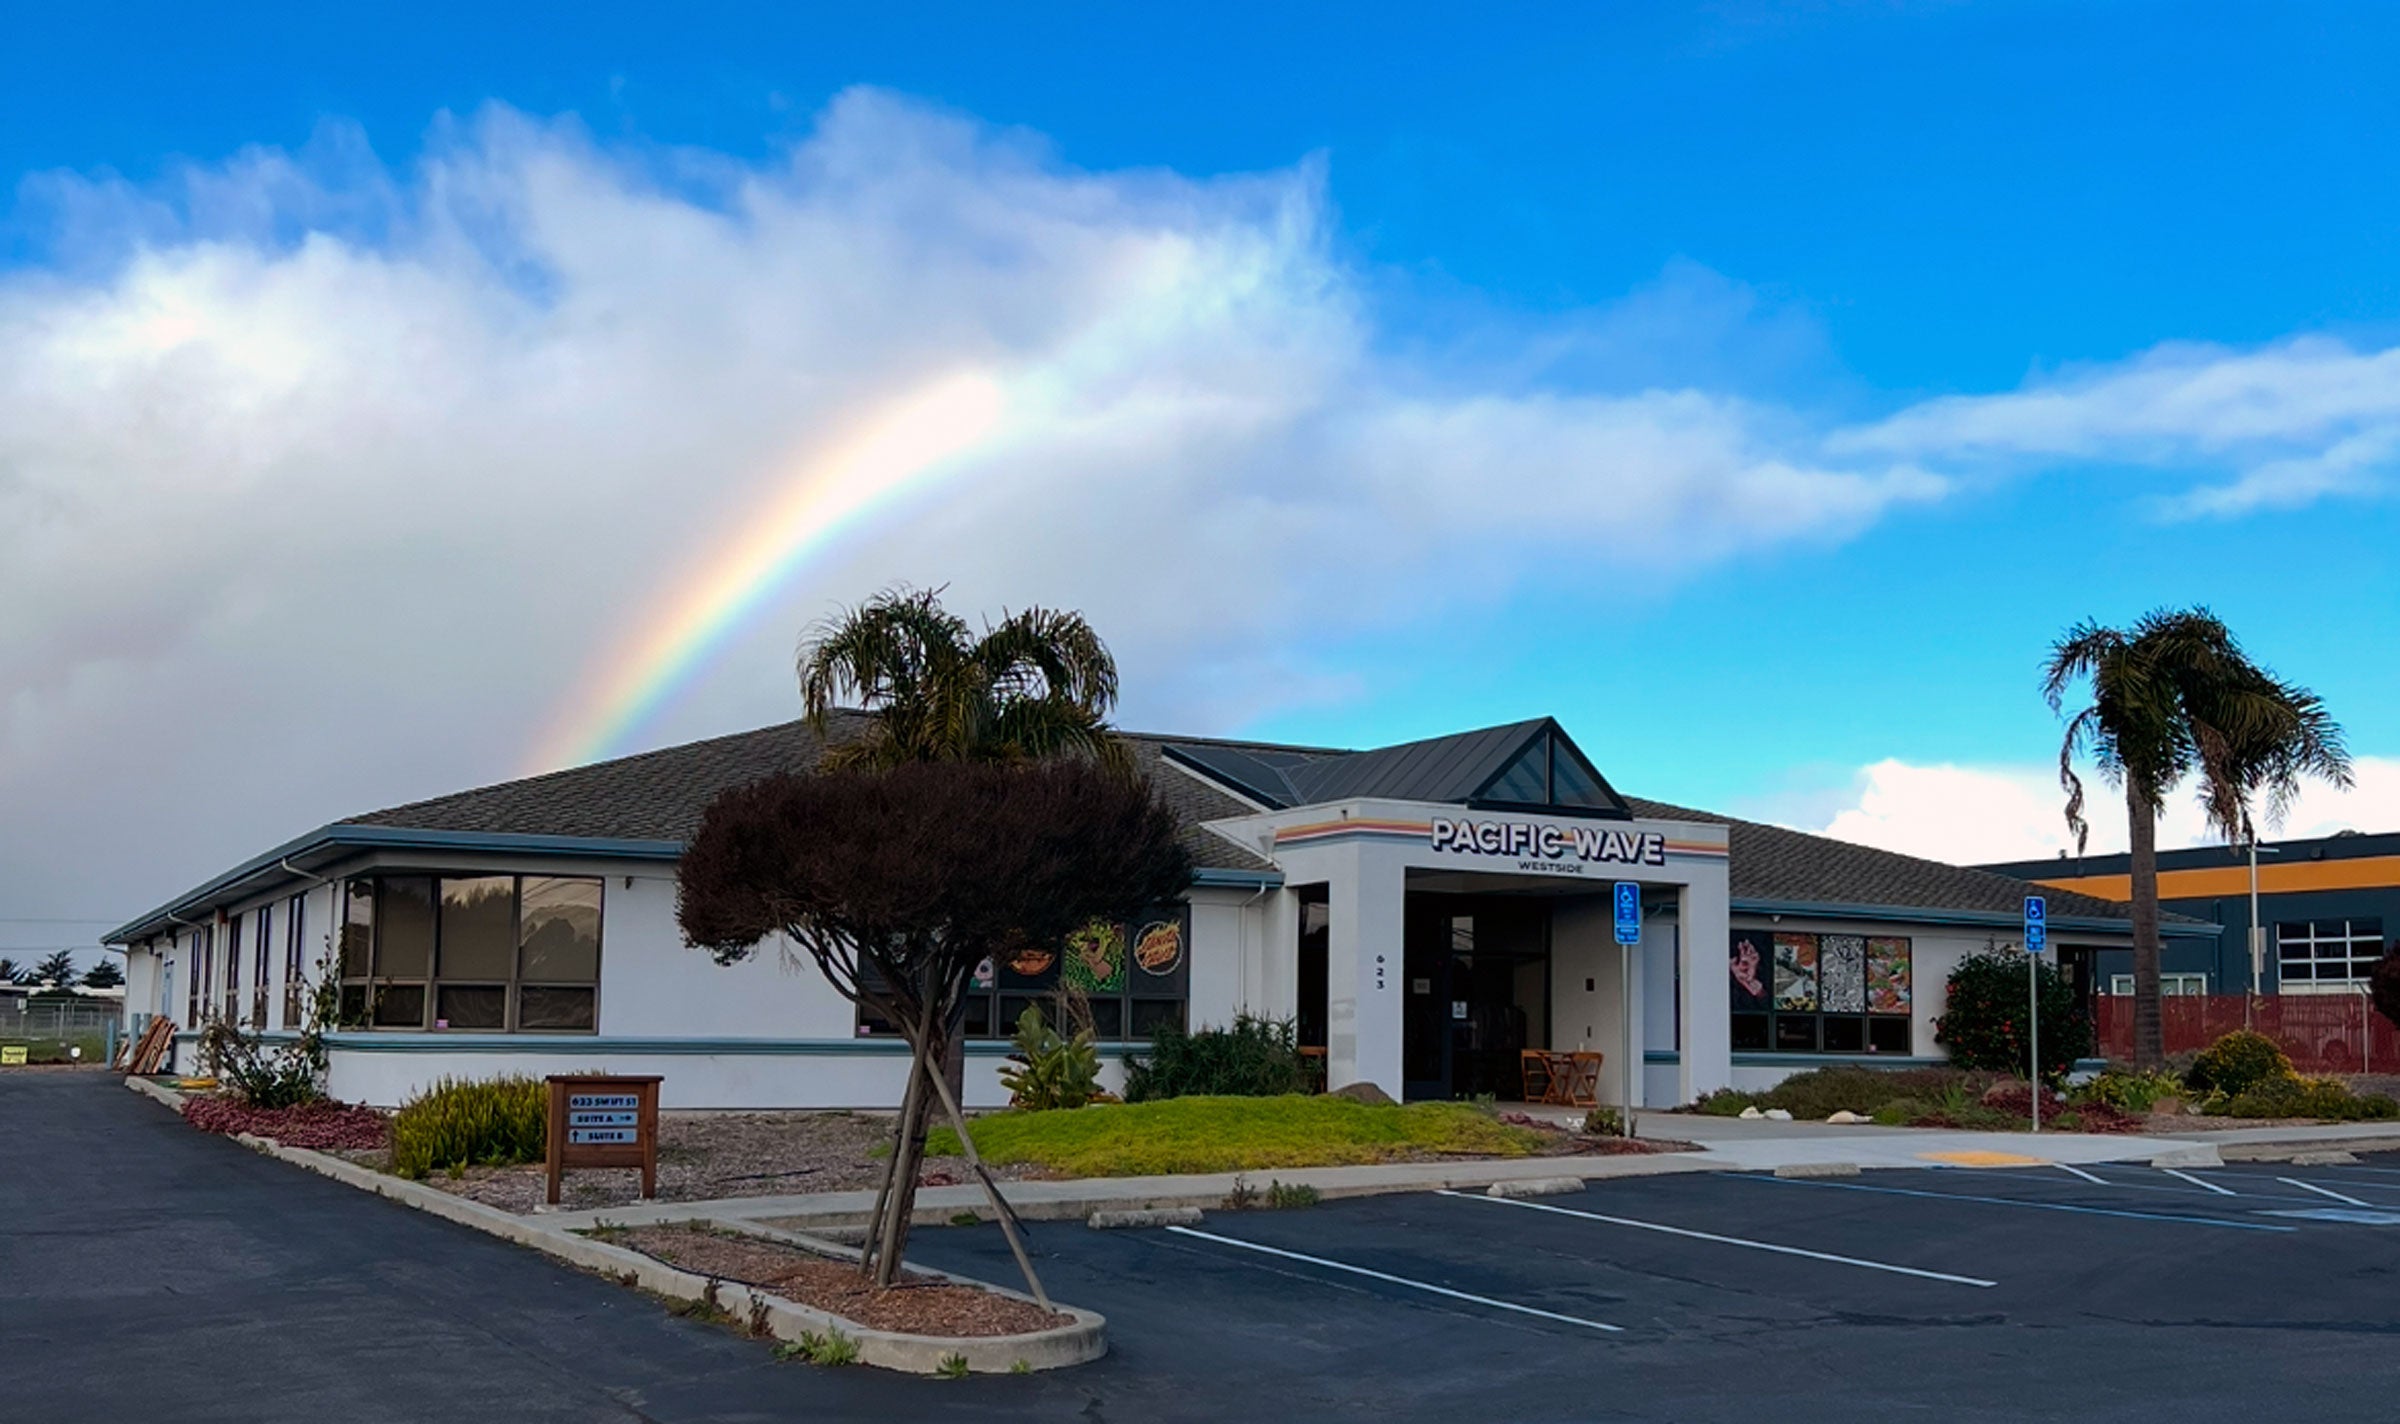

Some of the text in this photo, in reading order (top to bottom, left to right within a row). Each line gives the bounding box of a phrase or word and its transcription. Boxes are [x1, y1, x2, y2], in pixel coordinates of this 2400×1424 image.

[1432, 818, 1665, 865] PACIFIC WAVE
[1517, 861, 1585, 874] WESTSIDE
[1375, 954, 1386, 990] 623
[625, 1097, 636, 1107] ST
[577, 1115, 613, 1123] SUITE A
[588, 1132, 615, 1140] SUITE
